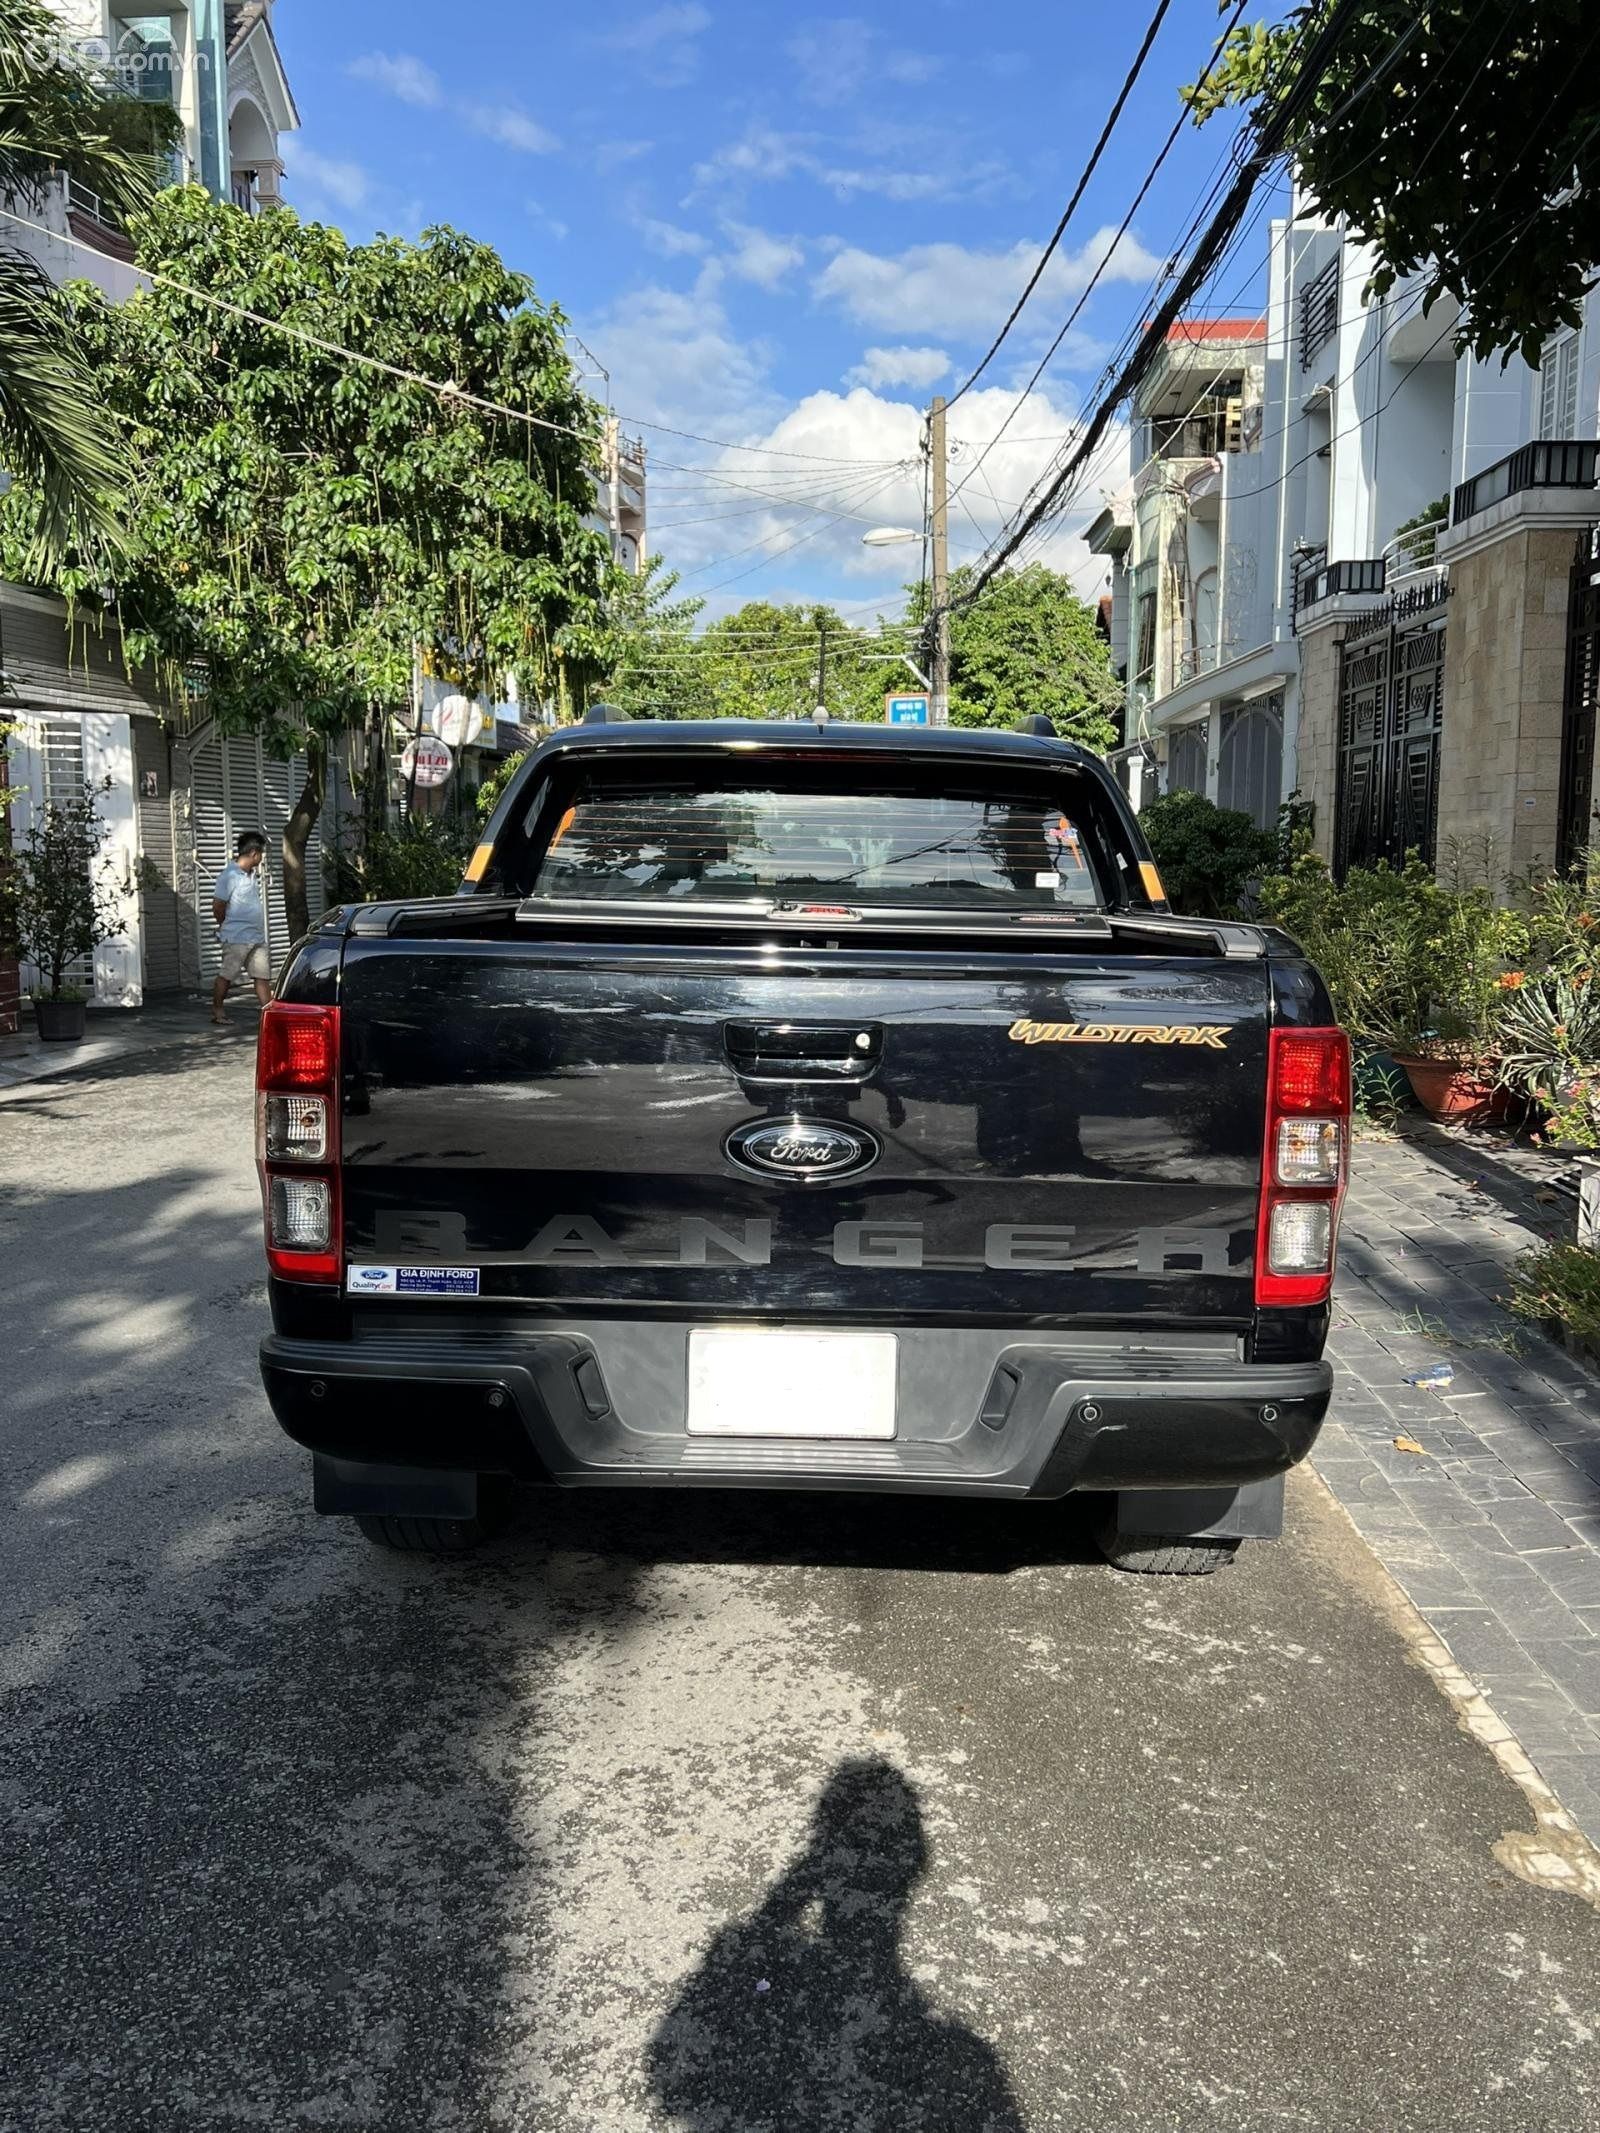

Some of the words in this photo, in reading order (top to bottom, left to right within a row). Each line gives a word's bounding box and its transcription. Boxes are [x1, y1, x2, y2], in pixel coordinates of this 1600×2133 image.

[1008, 1019, 1233, 1048] WILDTRAK
[770, 1132, 832, 1162] Ford
[375, 1209, 1230, 1273] RANGER
[400, 1269, 418, 1277] GIA
[419, 1270, 445, 1280] ĐỊNH
[446, 1270, 474, 1279] FORD
